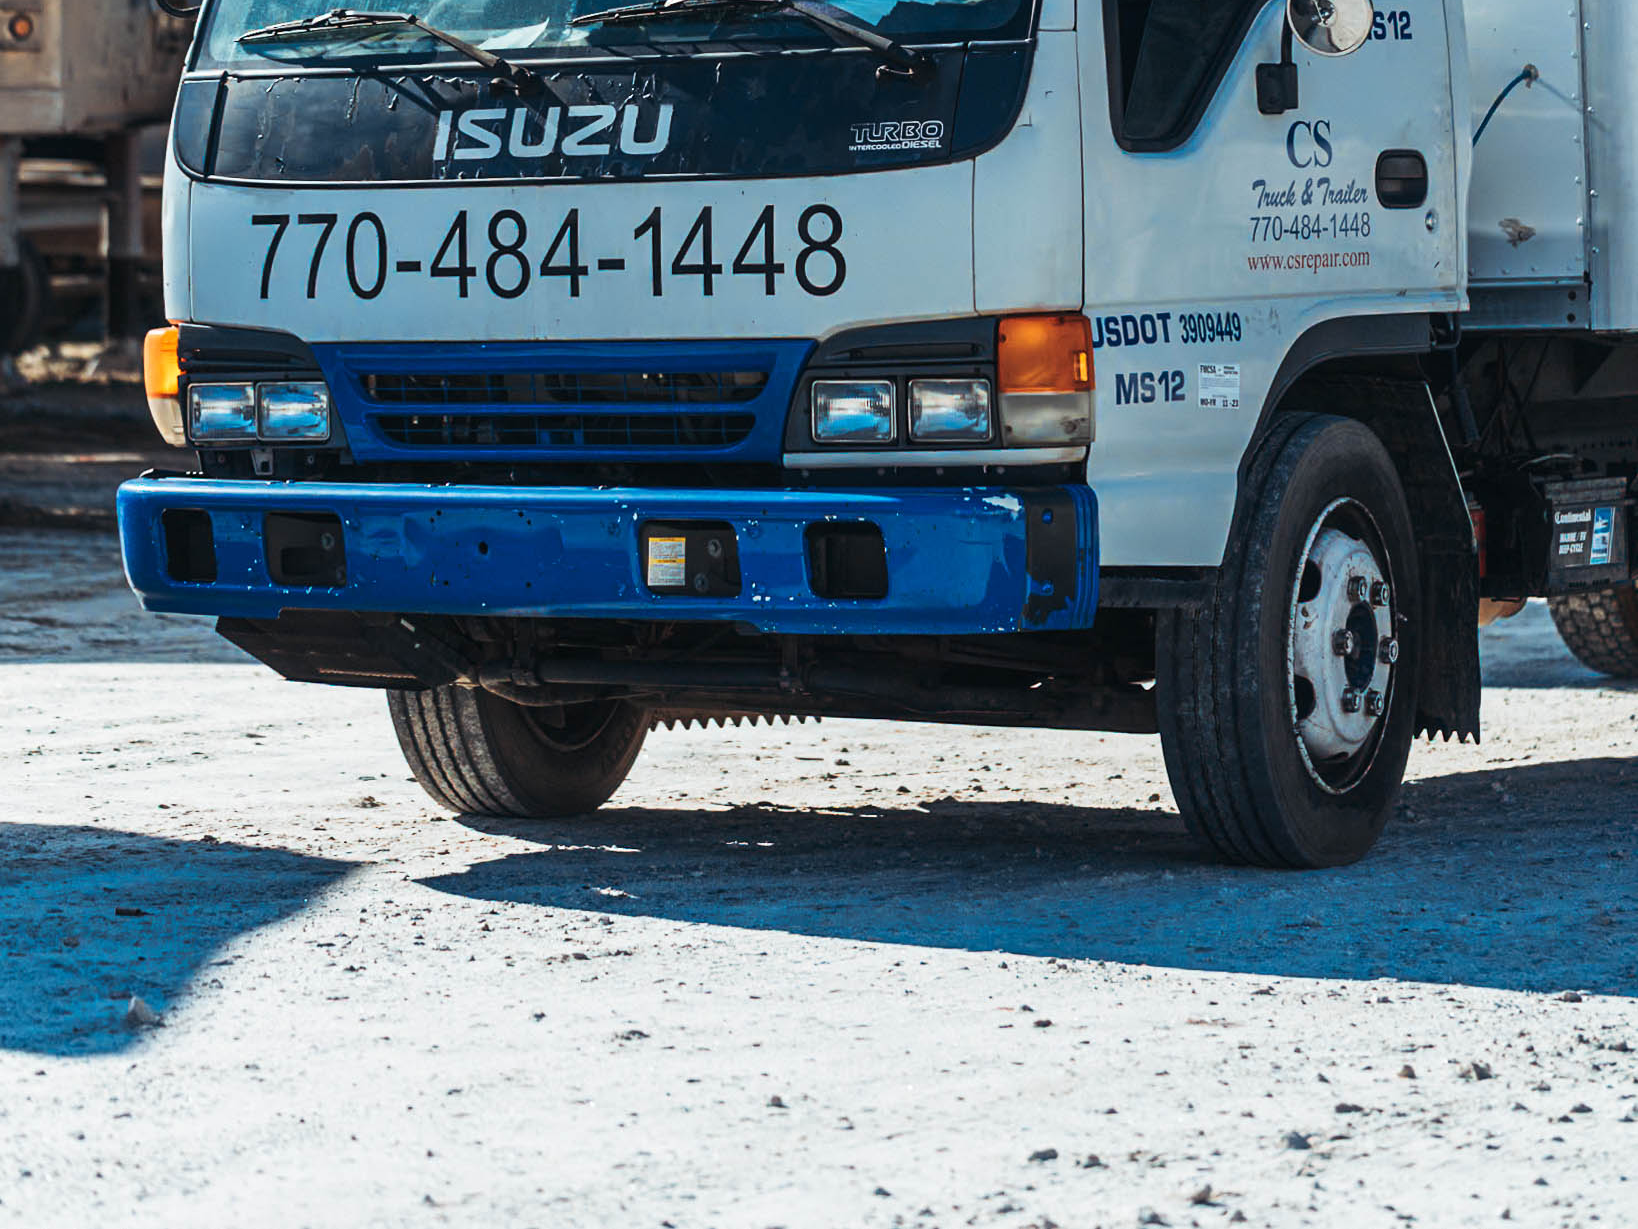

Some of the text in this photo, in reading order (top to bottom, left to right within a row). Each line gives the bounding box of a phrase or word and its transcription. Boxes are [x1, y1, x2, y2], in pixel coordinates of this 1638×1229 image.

[1368, 11, 1412, 40] S12
[432, 104, 675, 161] ISUZU
[848, 140, 942, 151] INTERCOOLED DIESEL
[850, 120, 943, 142] TURBO
[1286, 120, 1332, 168] CS
[1252, 177, 1368, 209] Truck & Trailer
[1250, 212, 1371, 243] 770-484-1448
[250, 204, 846, 299] 770-484-1448
[1248, 251, 1370, 274] www.csrepair.com
[1179, 312, 1242, 344] 3909449
[1115, 370, 1185, 405] MS12
[1554, 509, 1591, 524] Continental
